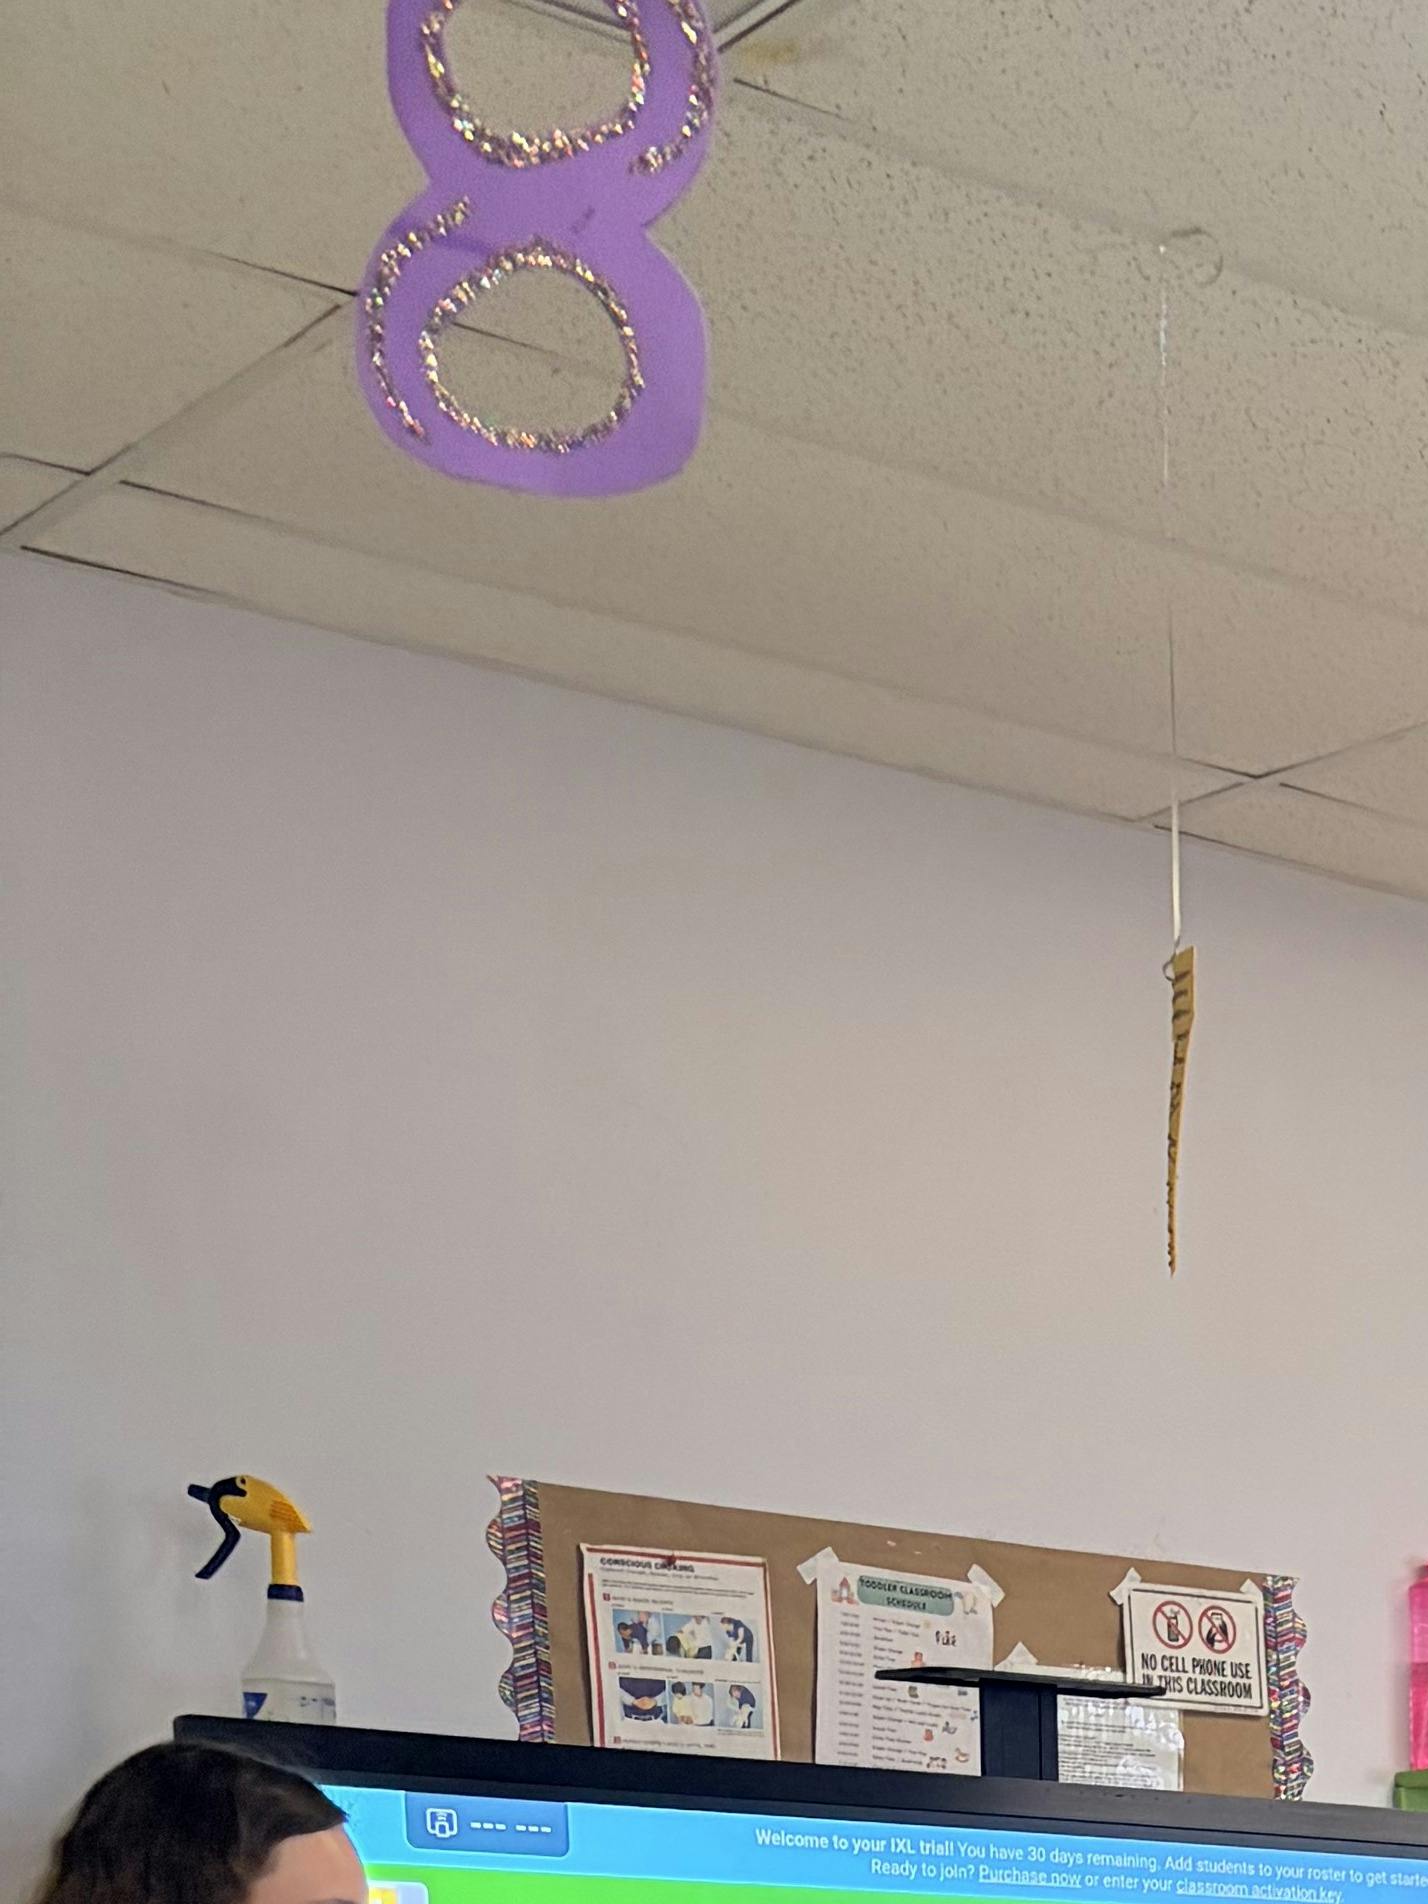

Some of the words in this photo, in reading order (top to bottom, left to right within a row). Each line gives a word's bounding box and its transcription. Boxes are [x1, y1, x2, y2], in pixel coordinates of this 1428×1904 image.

[900, 1584, 953, 1600] CLASSROOM
[1141, 1653, 1158, 1671] NO
[1160, 1654, 1189, 1674] CELL
[1191, 1657, 1227, 1679] PHONE
[1230, 1661, 1253, 1680] USE
[1186, 1677, 1253, 1700] CLASSROOM
[755, 1828, 830, 1849] Welcome
[832, 1835, 848, 1850] to
[852, 1838, 887, 1856] your
[890, 1838, 916, 1854] IXL
[919, 1840, 955, 1857] trial!
[957, 1841, 986, 1859] You
[989, 1844, 1024, 1861] have
[1026, 1846, 1046, 1862] 30
[1049, 1848, 1084, 1867] days
[1165, 1855, 1194, 1874] Add
[1196, 1857, 1256, 1877] students
[1258, 1862, 1273, 1878] to
[1275, 1865, 1304, 1882] your
[1307, 1866, 1347, 1883] roster
[1349, 1868, 1364, 1884] to
[1366, 1871, 1388, 1888] get
[871, 1858, 918, 1879] Ready
[921, 1862, 937, 1878] to
[940, 1862, 976, 1882] join?
[979, 1865, 1048, 1885] Purchase
[1050, 1872, 1083, 1888] now
[1084, 1874, 1100, 1888] or
[1102, 1875, 1139, 1891] enter
[1142, 1879, 1174, 1896] your
[1176, 1878, 1249, 1899] classroom
[1252, 1882, 1316, 1902] activation
